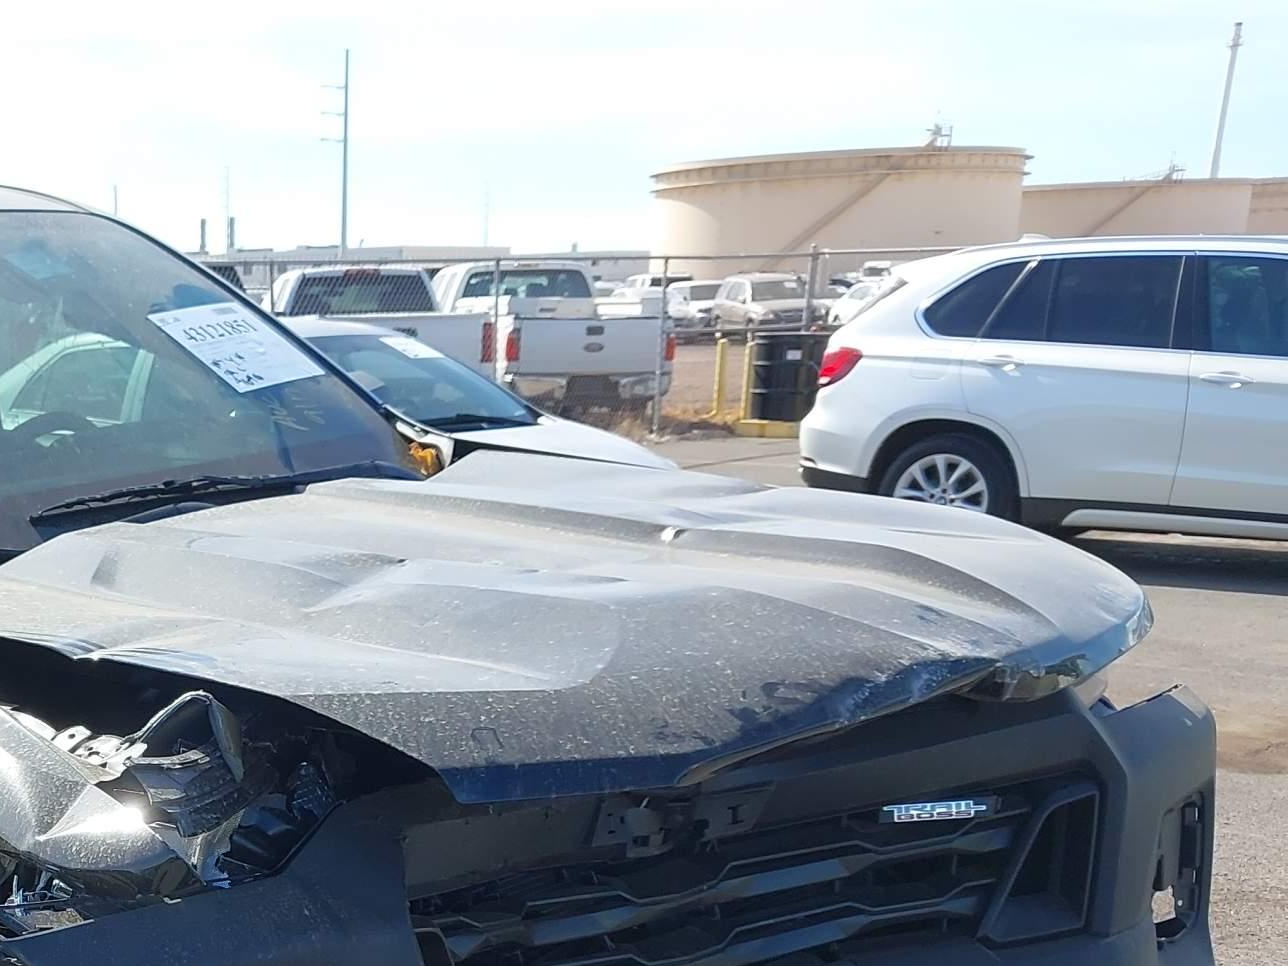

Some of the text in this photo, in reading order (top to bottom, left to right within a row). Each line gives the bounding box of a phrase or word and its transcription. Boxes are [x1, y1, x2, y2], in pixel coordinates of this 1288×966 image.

[183, 319, 258, 342] 43121851
[882, 800, 987, 814] TRAIL
[894, 809, 974, 822] BOSS
